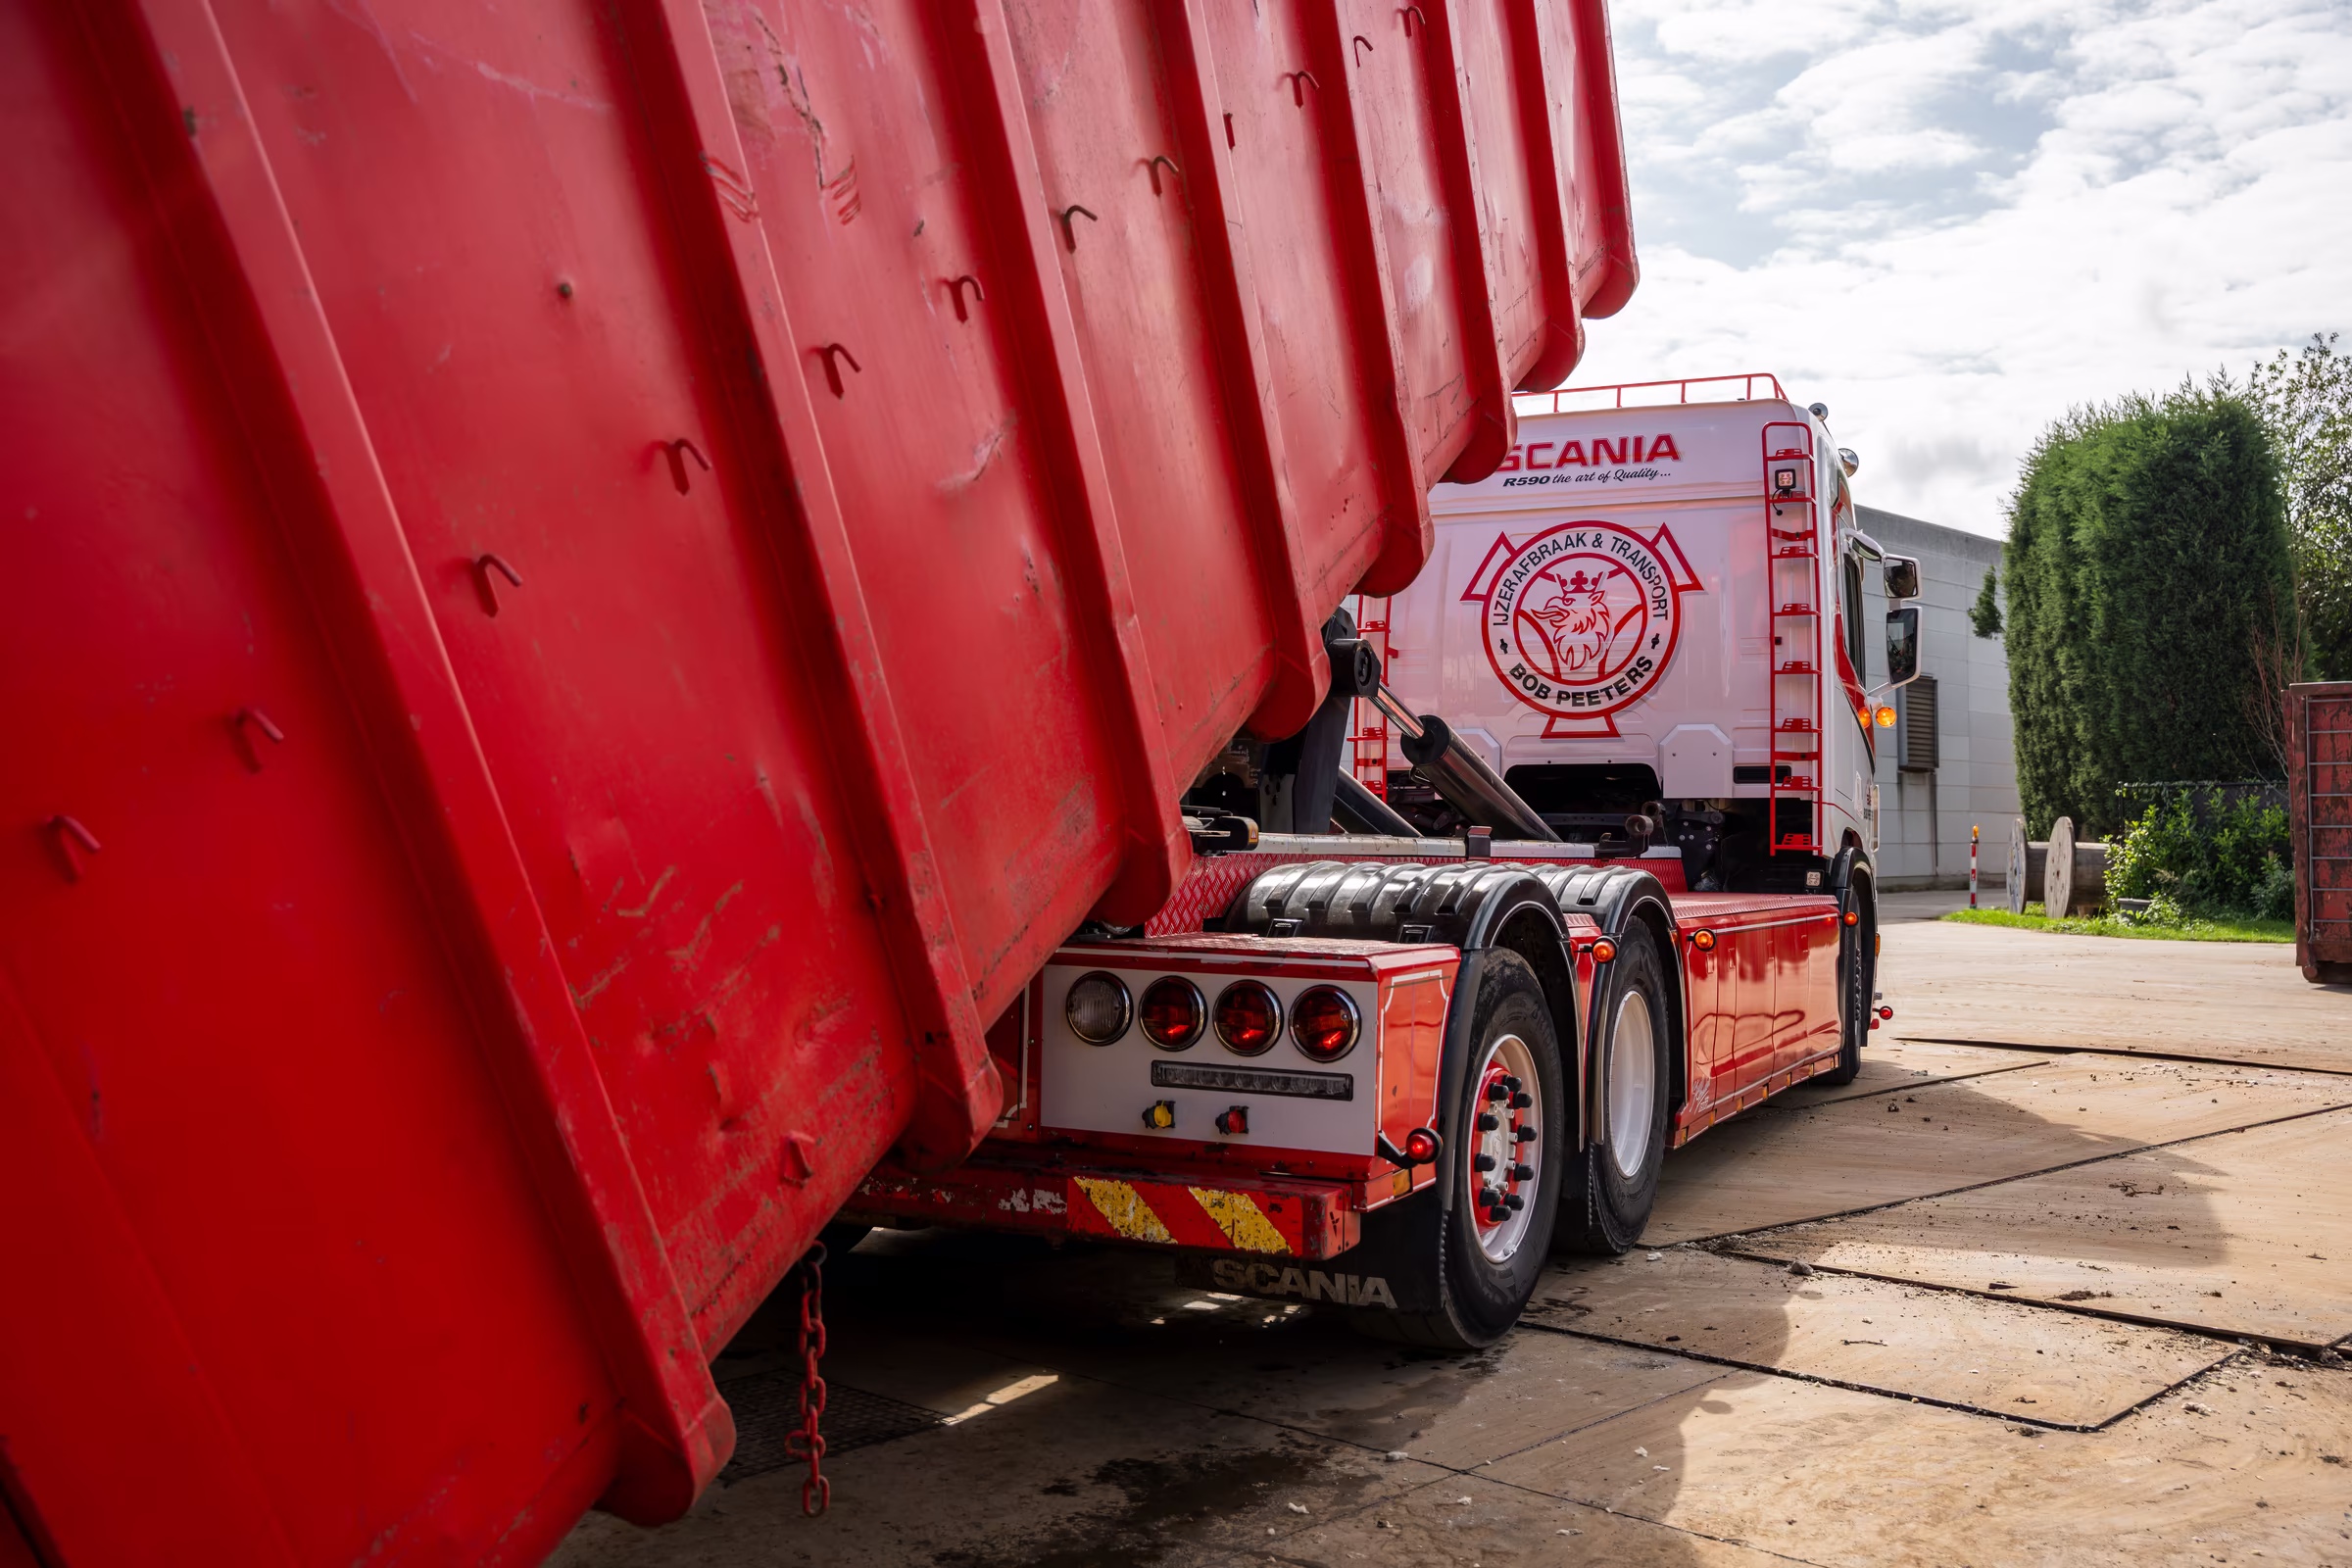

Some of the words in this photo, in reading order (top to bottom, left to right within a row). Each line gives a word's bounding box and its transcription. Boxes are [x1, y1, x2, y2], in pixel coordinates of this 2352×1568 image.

[1497, 433, 1681, 472] SCANIA
[1503, 475, 1550, 487] R590
[1552, 474, 1572, 484] the
[1575, 471, 1595, 482] art
[1597, 469, 1611, 483] of
[1493, 532, 1587, 626] IJZERAFBRAAK
[1592, 532, 1603, 549] &
[1610, 536, 1668, 621] TRANSPORT
[1509, 662, 1551, 700] BOB
[1555, 656, 1653, 707] PEETERS
[1213, 1258, 1397, 1309] SCANIA
